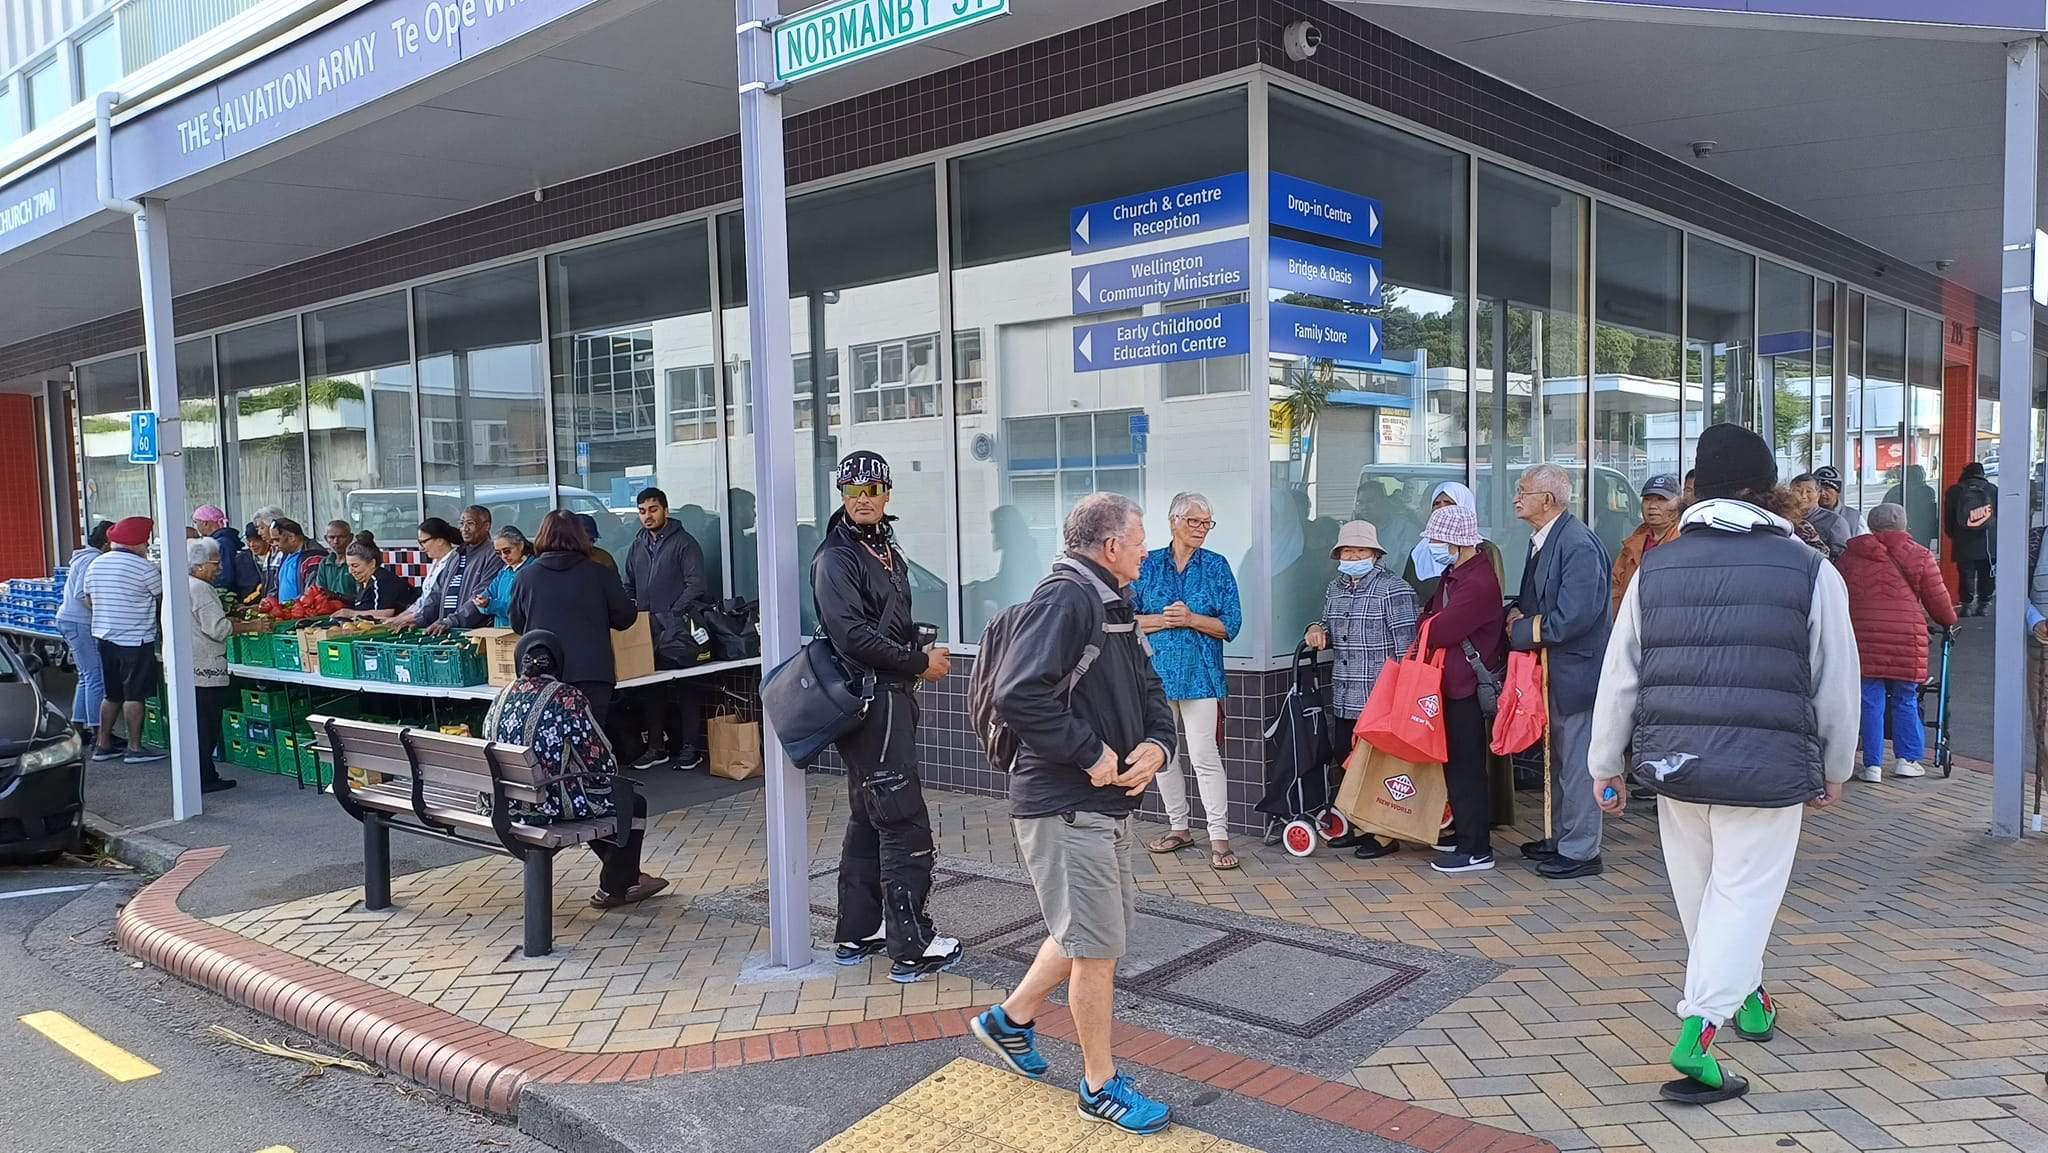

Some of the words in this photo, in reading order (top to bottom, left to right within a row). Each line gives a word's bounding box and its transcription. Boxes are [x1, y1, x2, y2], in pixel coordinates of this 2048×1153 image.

[787, 0, 929, 69] NORMANBY
[177, 112, 211, 154] THE
[213, 64, 312, 141] SALVATION
[317, 31, 376, 96] ARMY
[391, 16, 419, 58] Te
[424, 0, 476, 48] Ope
[33, 187, 56, 219] 7PM
[1113, 198, 1157, 220] Church
[1162, 195, 1172, 211] &
[1176, 188, 1222, 208] Centre
[1288, 194, 1322, 217] Drop-in
[1324, 204, 1352, 224] Centre
[1133, 213, 1200, 237] Reception
[1131, 255, 1203, 278] Wellington
[1288, 259, 1318, 281] Bridge
[1320, 264, 1327, 280] &
[1328, 267, 1352, 284] Oasis
[1099, 279, 1170, 303] Community
[1173, 268, 1241, 291] Ministries
[1117, 324, 1149, 342] Early
[1152, 312, 1222, 336] Childhood
[1294, 322, 1324, 344] Family
[1324, 329, 1348, 344] Store
[1113, 340, 1177, 361] Education
[1181, 335, 1227, 352] Centre
[138, 415, 148, 434] P
[140, 436, 149, 451] 60
[1969, 504, 1992, 521] NIKE
[1392, 781, 1411, 793] NW
